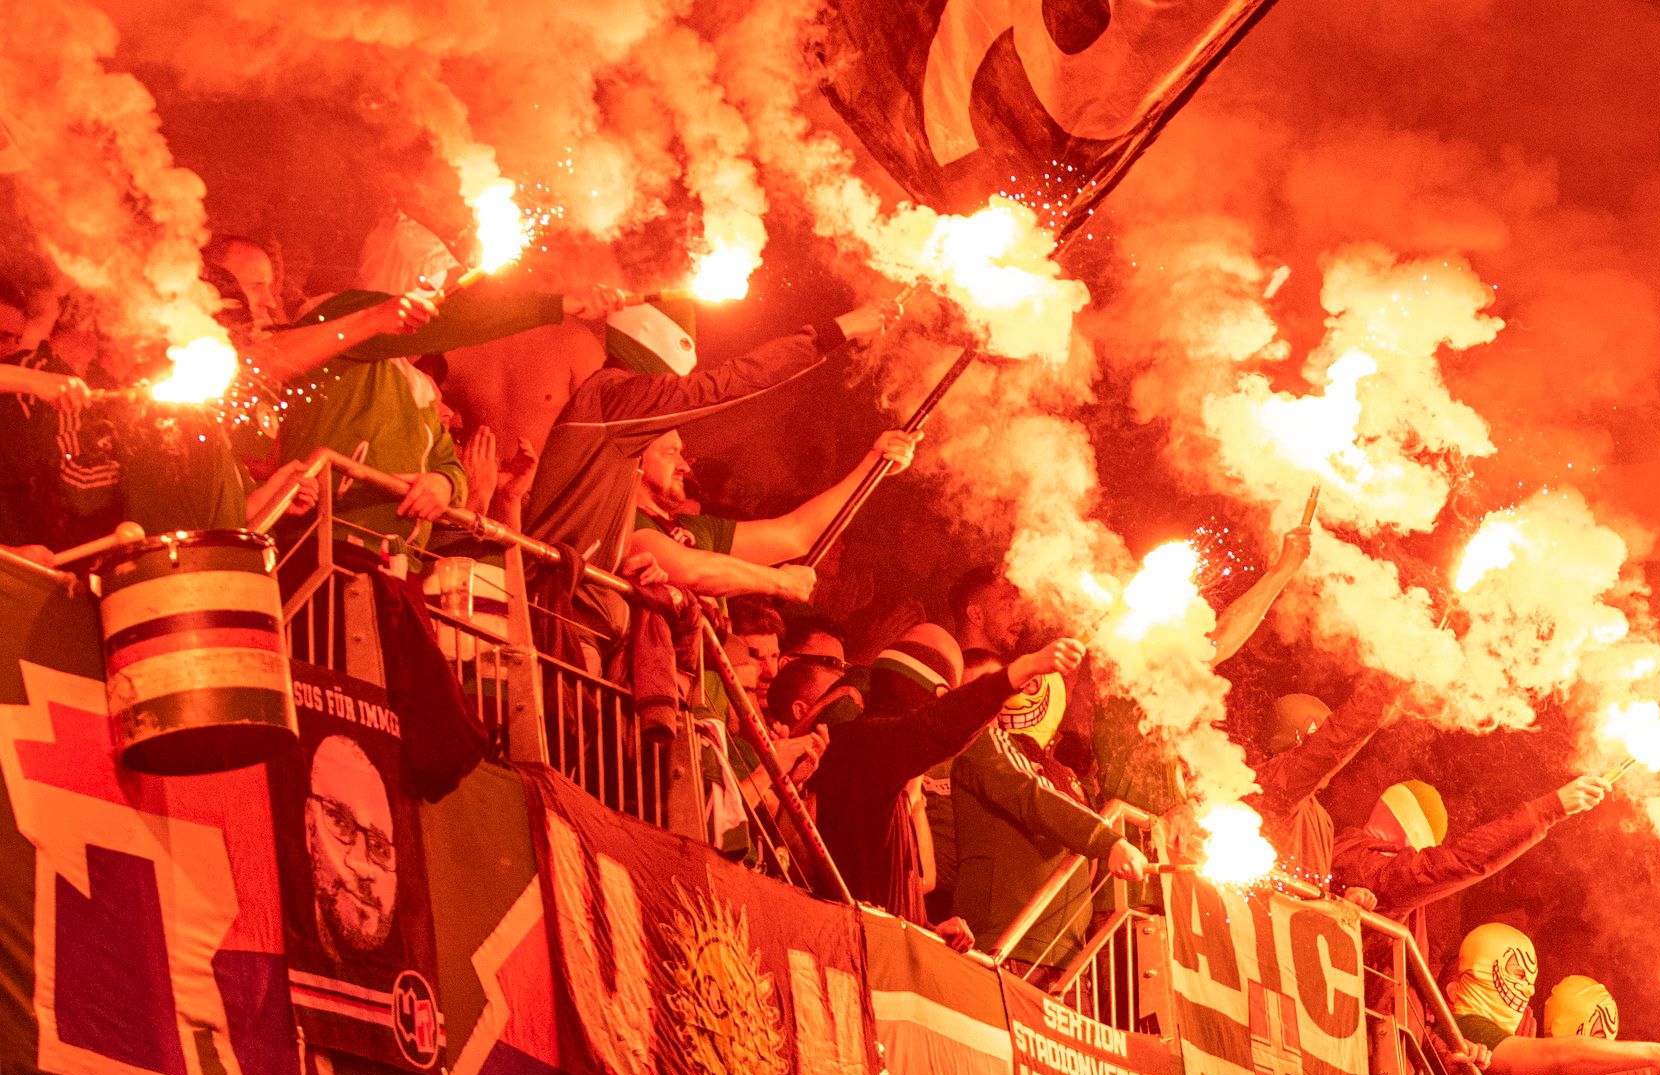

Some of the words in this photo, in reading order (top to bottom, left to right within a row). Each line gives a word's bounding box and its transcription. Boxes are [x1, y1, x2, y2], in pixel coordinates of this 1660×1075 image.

[293, 680, 323, 712] SUS
[325, 685, 356, 722] FÜR
[357, 699, 401, 740] IMME
